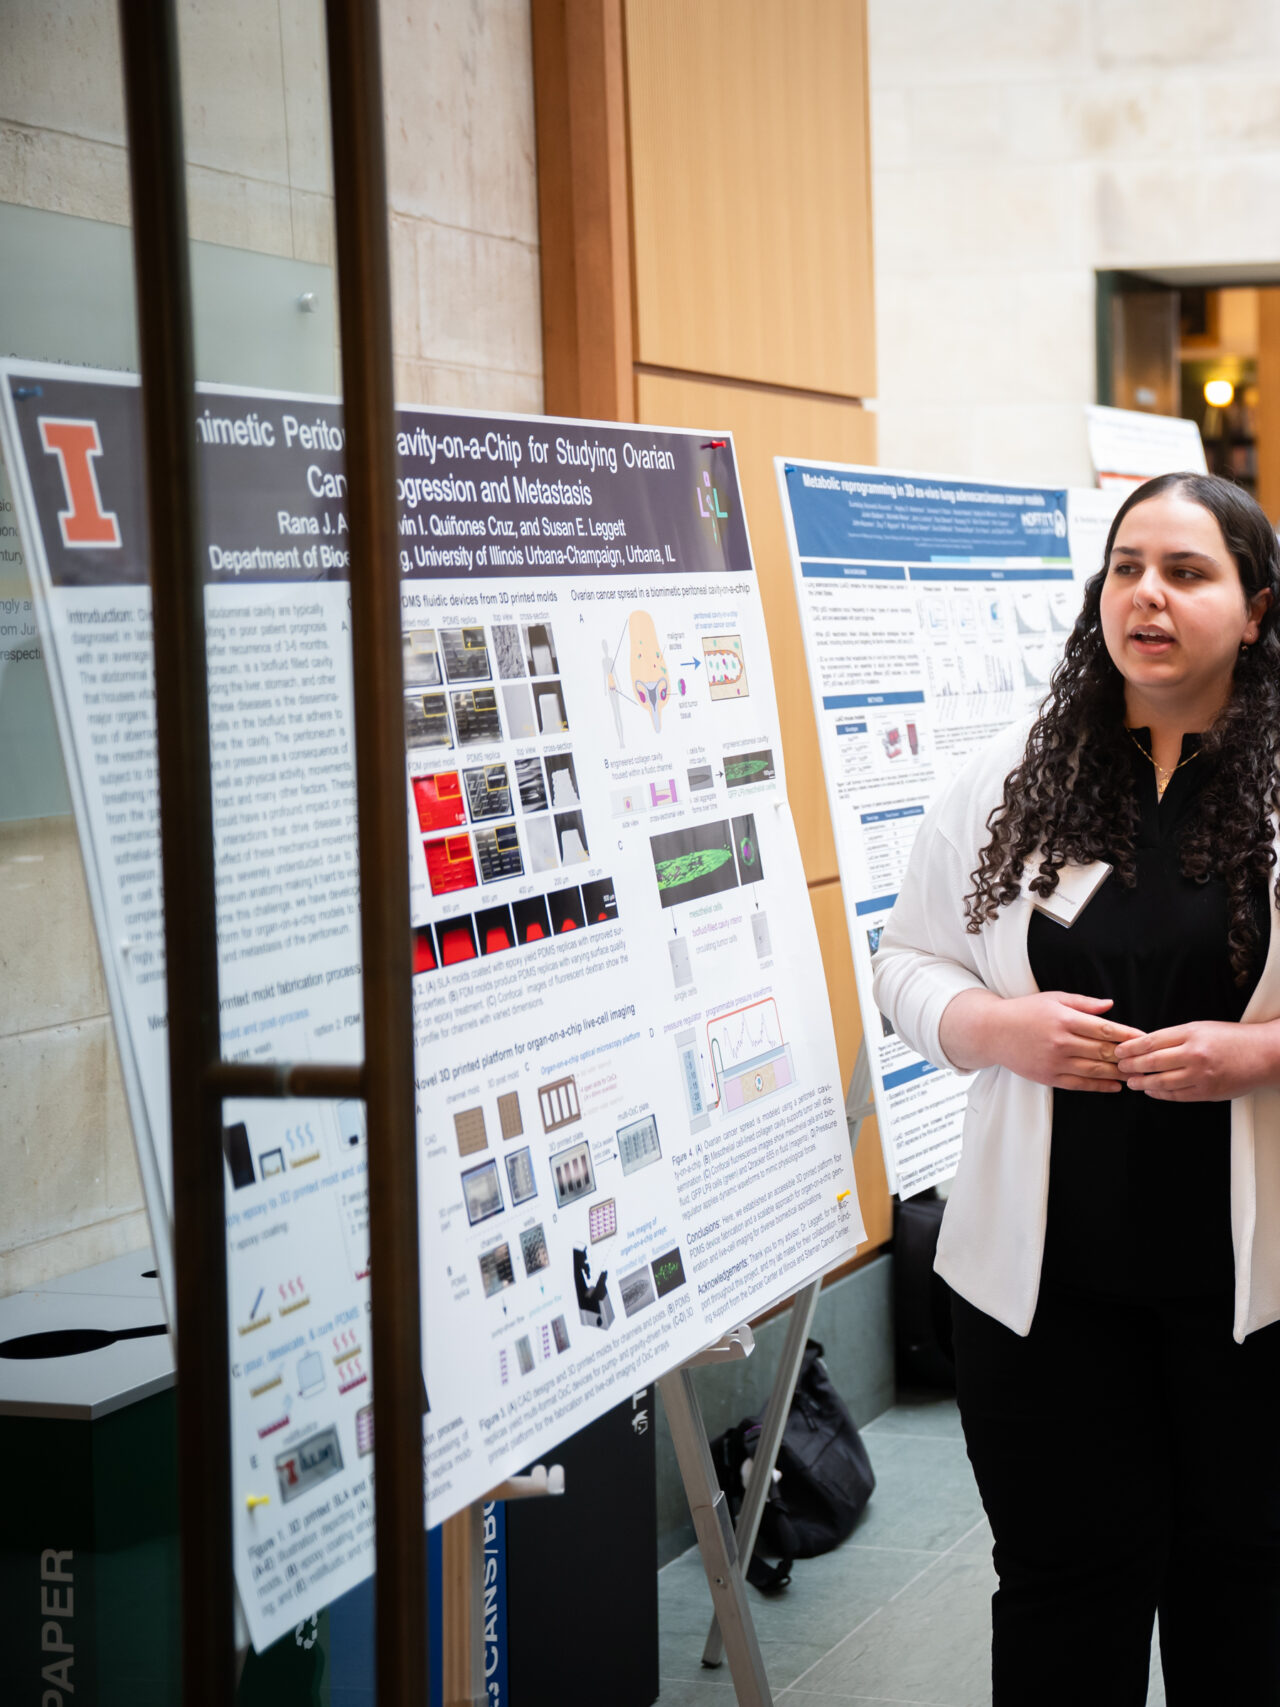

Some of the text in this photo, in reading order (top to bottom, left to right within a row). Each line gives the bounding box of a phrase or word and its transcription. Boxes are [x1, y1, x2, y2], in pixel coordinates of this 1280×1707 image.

[282, 415, 346, 450] Perito
[396, 427, 522, 468] avity-on-a-Chip
[528, 435, 549, 464] for
[556, 437, 617, 473] Studying
[623, 443, 675, 470] Ovarian
[37, 416, 122, 548] I
[307, 464, 347, 498] Can
[481, 479, 511, 504] and
[516, 476, 593, 505] Metastasis
[802, 473, 841, 490] Metabolic
[897, 484, 904, 496] in
[904, 484, 914, 497] 3D
[277, 511, 320, 535] Rana
[322, 512, 336, 535] J.
[419, 515, 428, 535] I.
[430, 514, 486, 536] Quiñones
[488, 516, 518, 538] Cruz,
[520, 519, 539, 536] and
[541, 517, 575, 537] Susan
[576, 518, 588, 537] E.
[588, 518, 626, 540] Leggett
[209, 545, 300, 575] Department
[303, 546, 318, 568] of
[415, 545, 473, 571] University
[476, 546, 488, 566] of
[489, 546, 524, 566] Illinois
[526, 546, 625, 568] Urbana-Champaign,
[627, 545, 665, 565] Urbana,
[665, 545, 676, 563] IL
[401, 590, 558, 608] DMS fluidic devices from 3D printed molds
[570, 589, 594, 601] Ovarian
[596, 590, 616, 600] cancer
[617, 588, 638, 601] spread
[639, 587, 644, 598] in
[646, 589, 650, 598] a
[650, 586, 681, 598] biomimetic
[579, 613, 584, 623] A
[415, 1004, 636, 1090] Novel 3D printed platform for organ-on-a-chip live-cell imaging
[834, 1154, 842, 1162] for
[40, 1549, 74, 1707] PAPER
